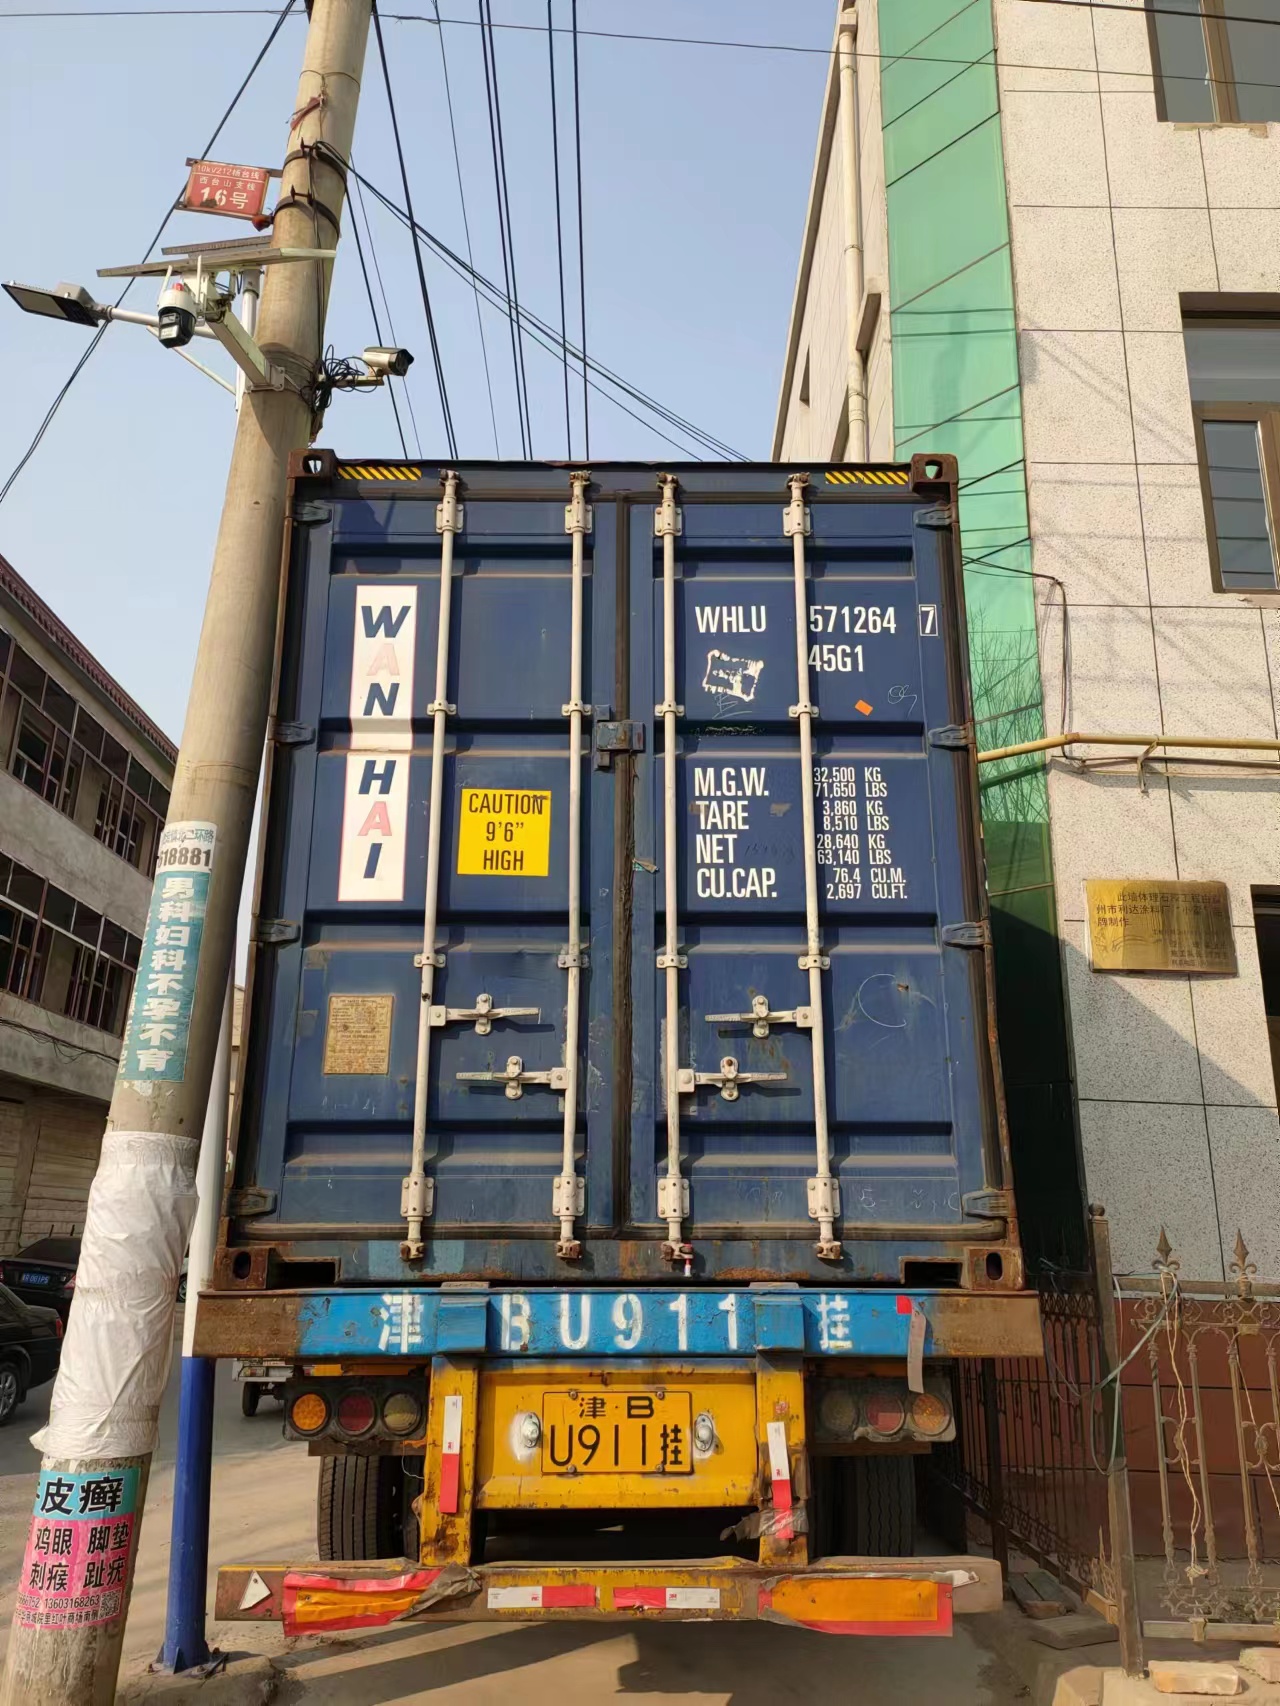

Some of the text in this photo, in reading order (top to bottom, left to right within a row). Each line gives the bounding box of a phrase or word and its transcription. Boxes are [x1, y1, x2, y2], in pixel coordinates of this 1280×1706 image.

[200, 186, 249, 210] 16号
[695, 605, 937, 635] WHLU 571264 7
[808, 644, 865, 672] 45G1
[357, 605, 411, 879] WAN HAI
[694, 767, 882, 797] M.G.W. 32,500 KG
[815, 782, 888, 799] 71,650 LBS
[468, 793, 545, 815] CAUTION
[695, 800, 883, 830] TARE 3,860 KG
[823, 816, 889, 832] 8,510 LBS
[483, 850, 524, 871] HIGH
[695, 834, 738, 864] NET
[816, 834, 859, 850] 28,640
[868, 834, 886, 849] KG
[817, 849, 860, 866] 63,140
[869, 850, 891, 865] LBS
[696, 868, 906, 898] CU.CAP. 76.4 CU.M.
[826, 884, 908, 900] 2,697 CU.FT.
[136, 876, 195, 1073] 男科妇科不孕不育
[378, 1292, 424, 1353] 津
[815, 1294, 853, 1351] 挂
[550, 1424, 684, 1467] U911挂
[36, 1476, 124, 1515] 皮癣
[35, 1522, 129, 1556] 鸡眼 脚垫
[29, 1561, 69, 1591] 刺瘊
[45, 1595, 100, 1609] 13603168263
